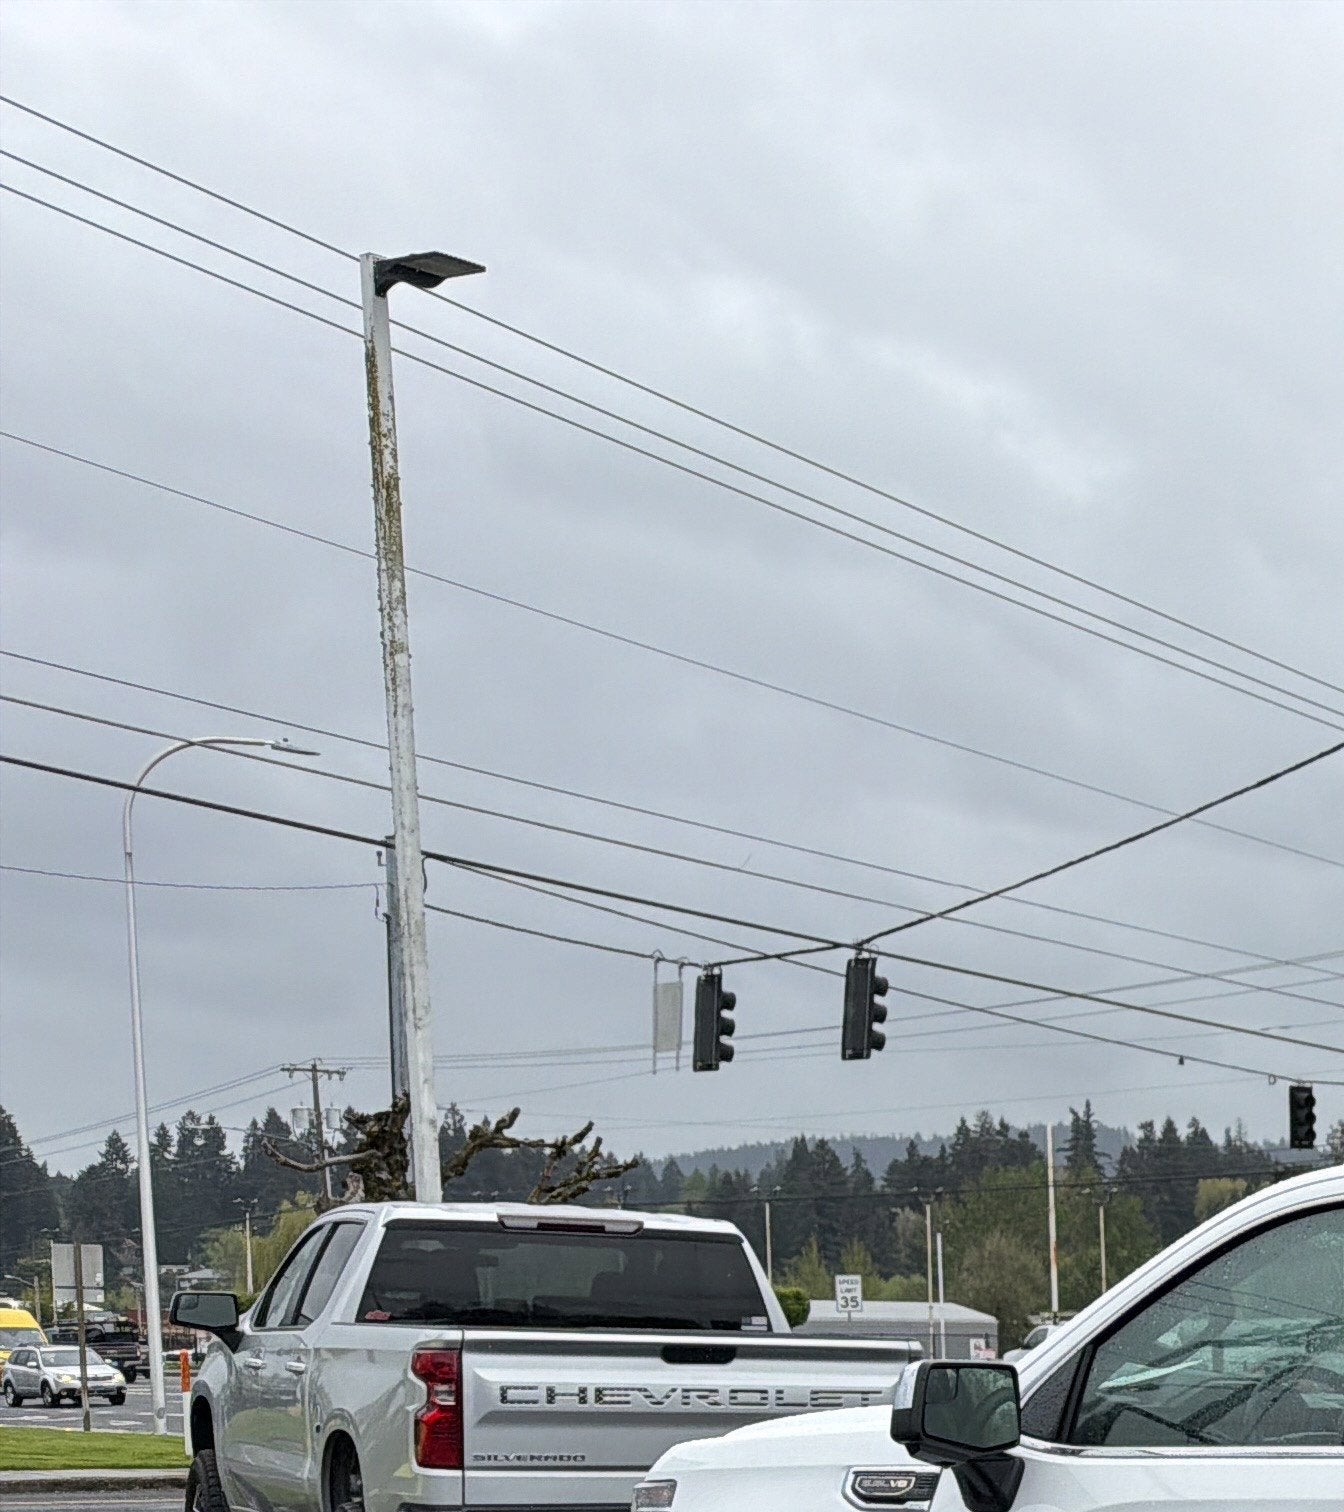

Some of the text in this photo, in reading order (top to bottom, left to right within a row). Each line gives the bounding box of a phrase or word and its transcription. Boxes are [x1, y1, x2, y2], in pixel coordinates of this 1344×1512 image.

[840, 1296, 860, 1309] 35
[499, 1384, 883, 1407] CHEVROLET
[473, 1453, 586, 1462] SILVERADO
